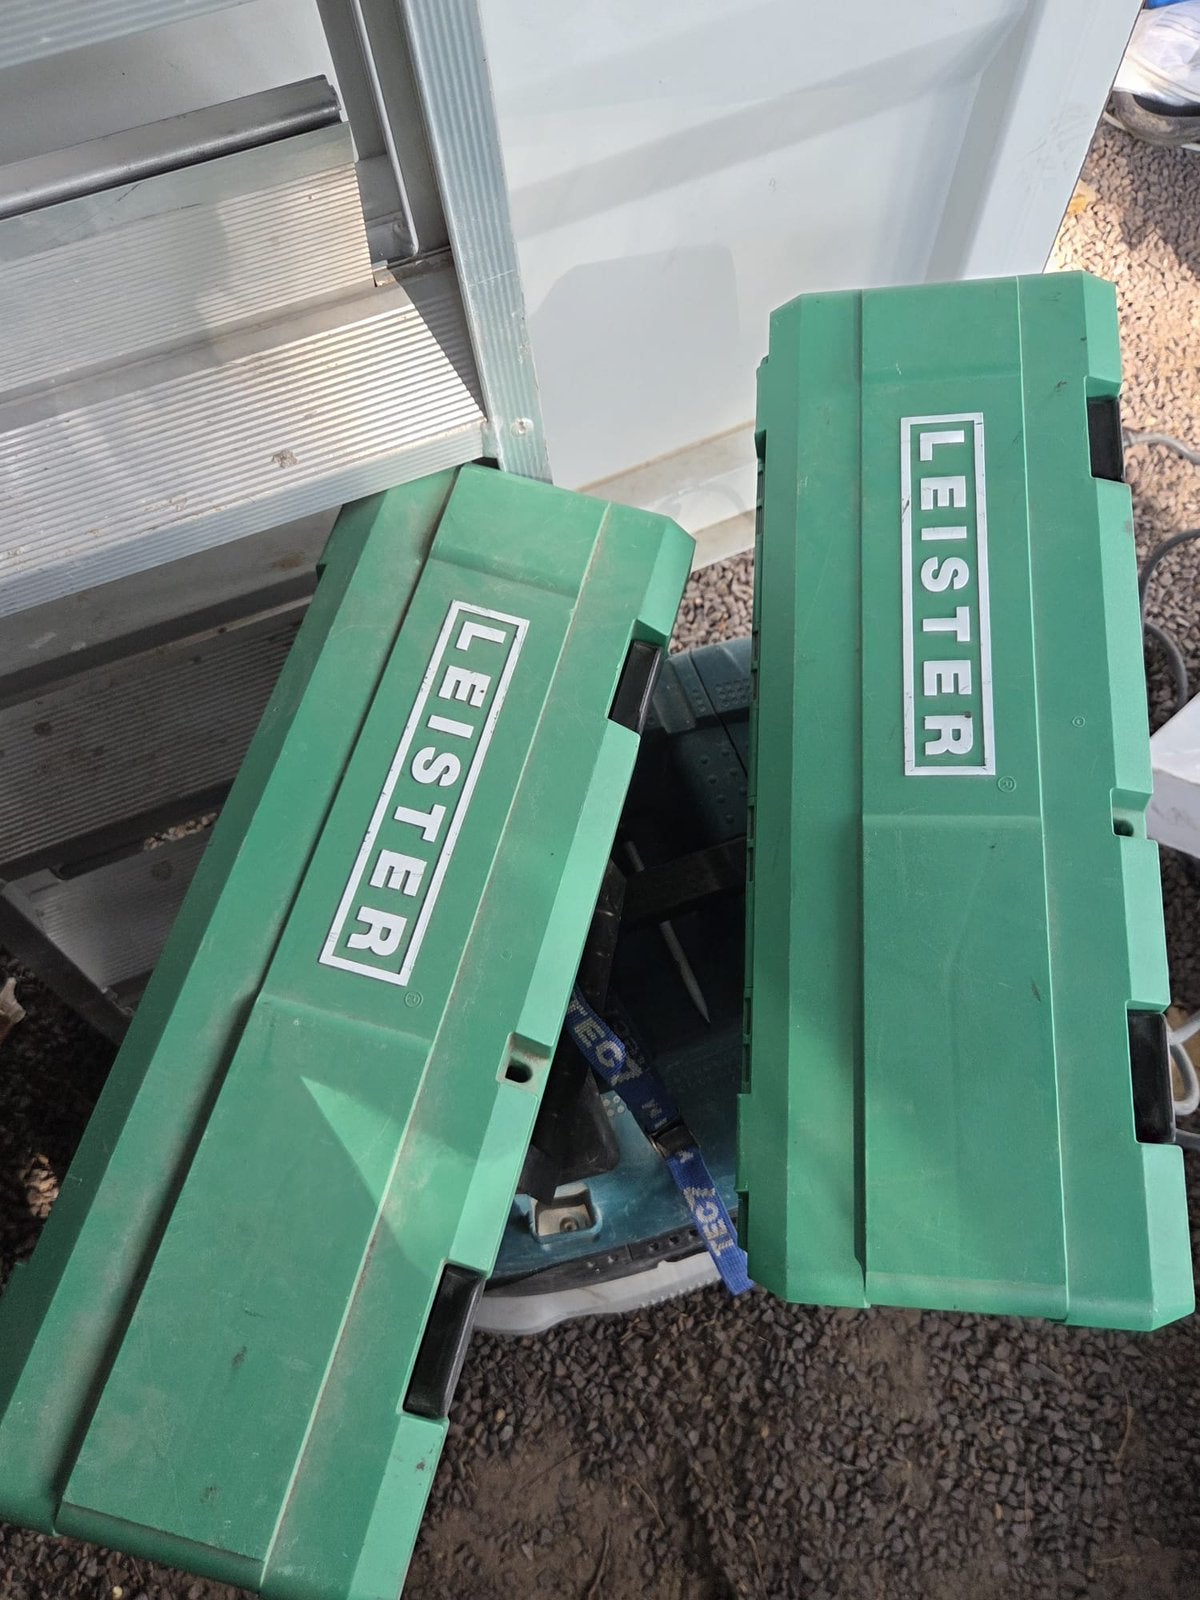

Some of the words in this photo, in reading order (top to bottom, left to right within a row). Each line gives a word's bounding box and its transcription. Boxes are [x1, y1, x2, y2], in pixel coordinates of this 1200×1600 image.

[919, 429, 974, 757] LEISTER
[346, 620, 507, 957] LEISTER
[683, 1187, 735, 1257] TEC7
